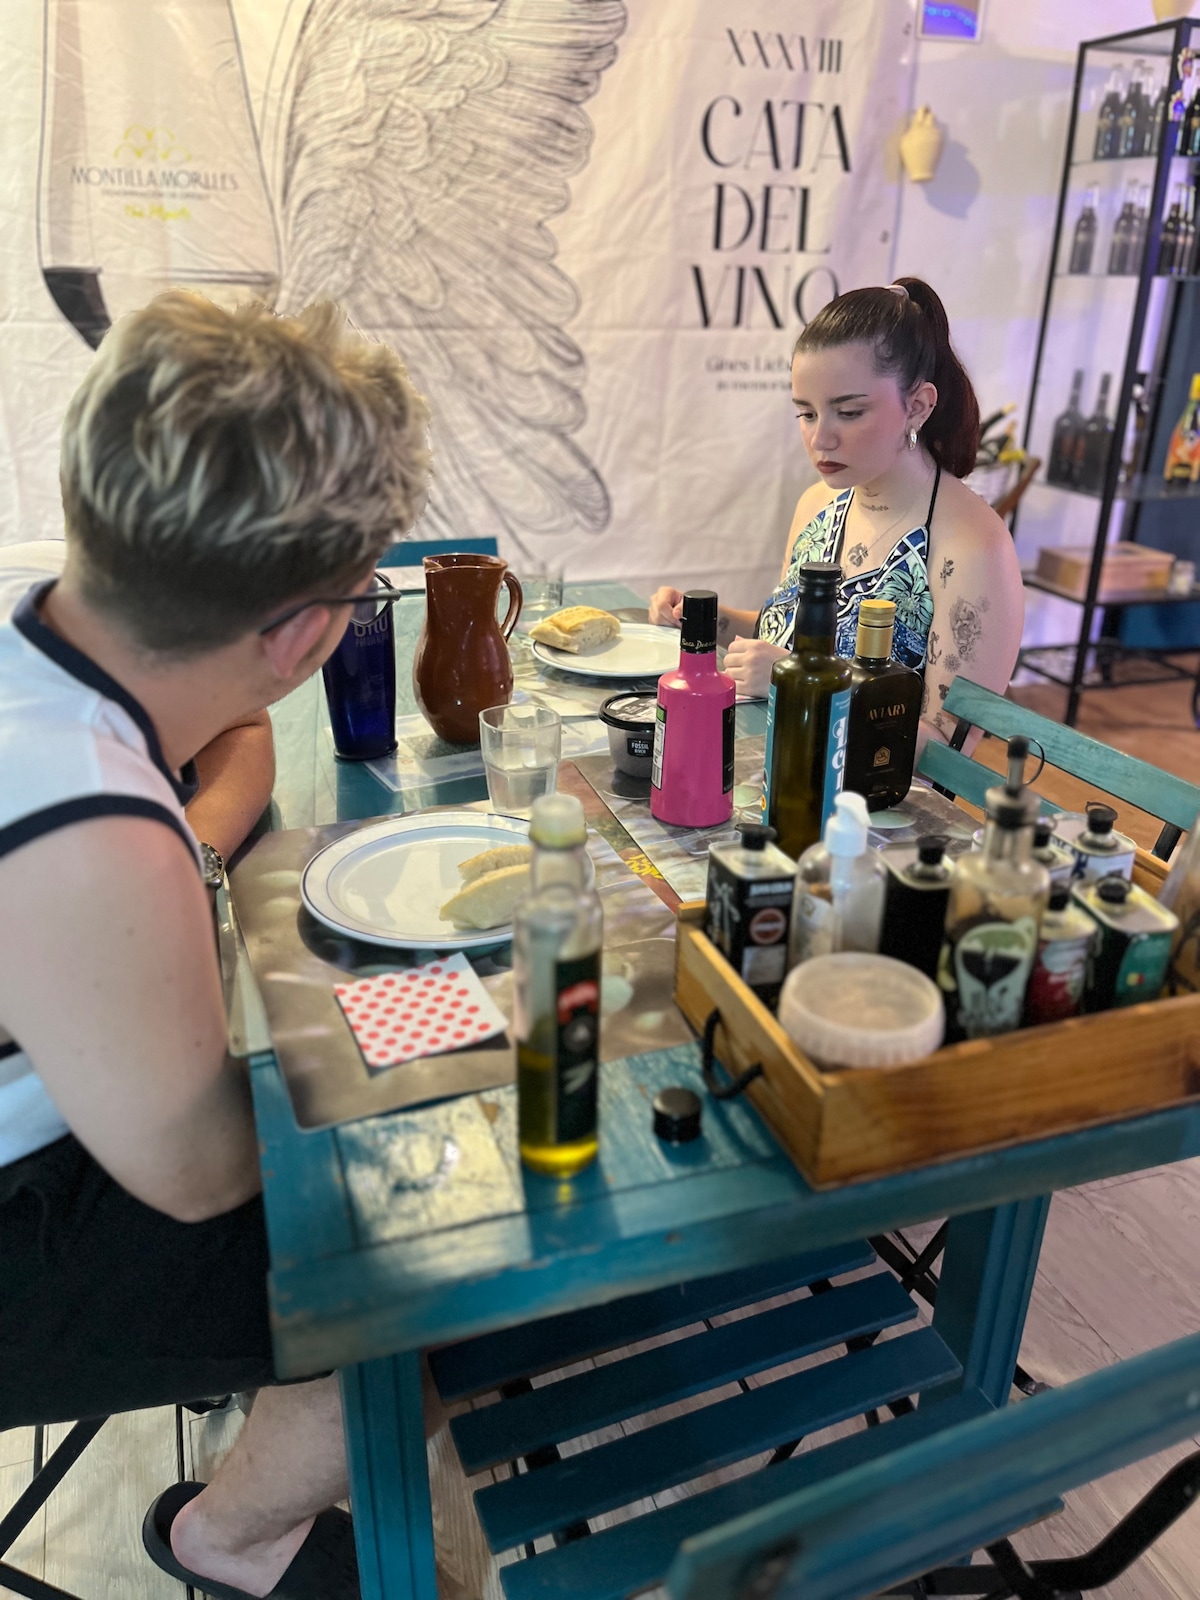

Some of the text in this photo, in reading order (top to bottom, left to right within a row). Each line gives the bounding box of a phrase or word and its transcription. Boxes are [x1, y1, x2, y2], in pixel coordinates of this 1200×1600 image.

[724, 27, 843, 74] XXXVIII
[700, 95, 852, 173] CATA
[713, 181, 832, 255] DEL
[691, 263, 840, 329] VINO
[868, 703, 907, 721] AVIARY
